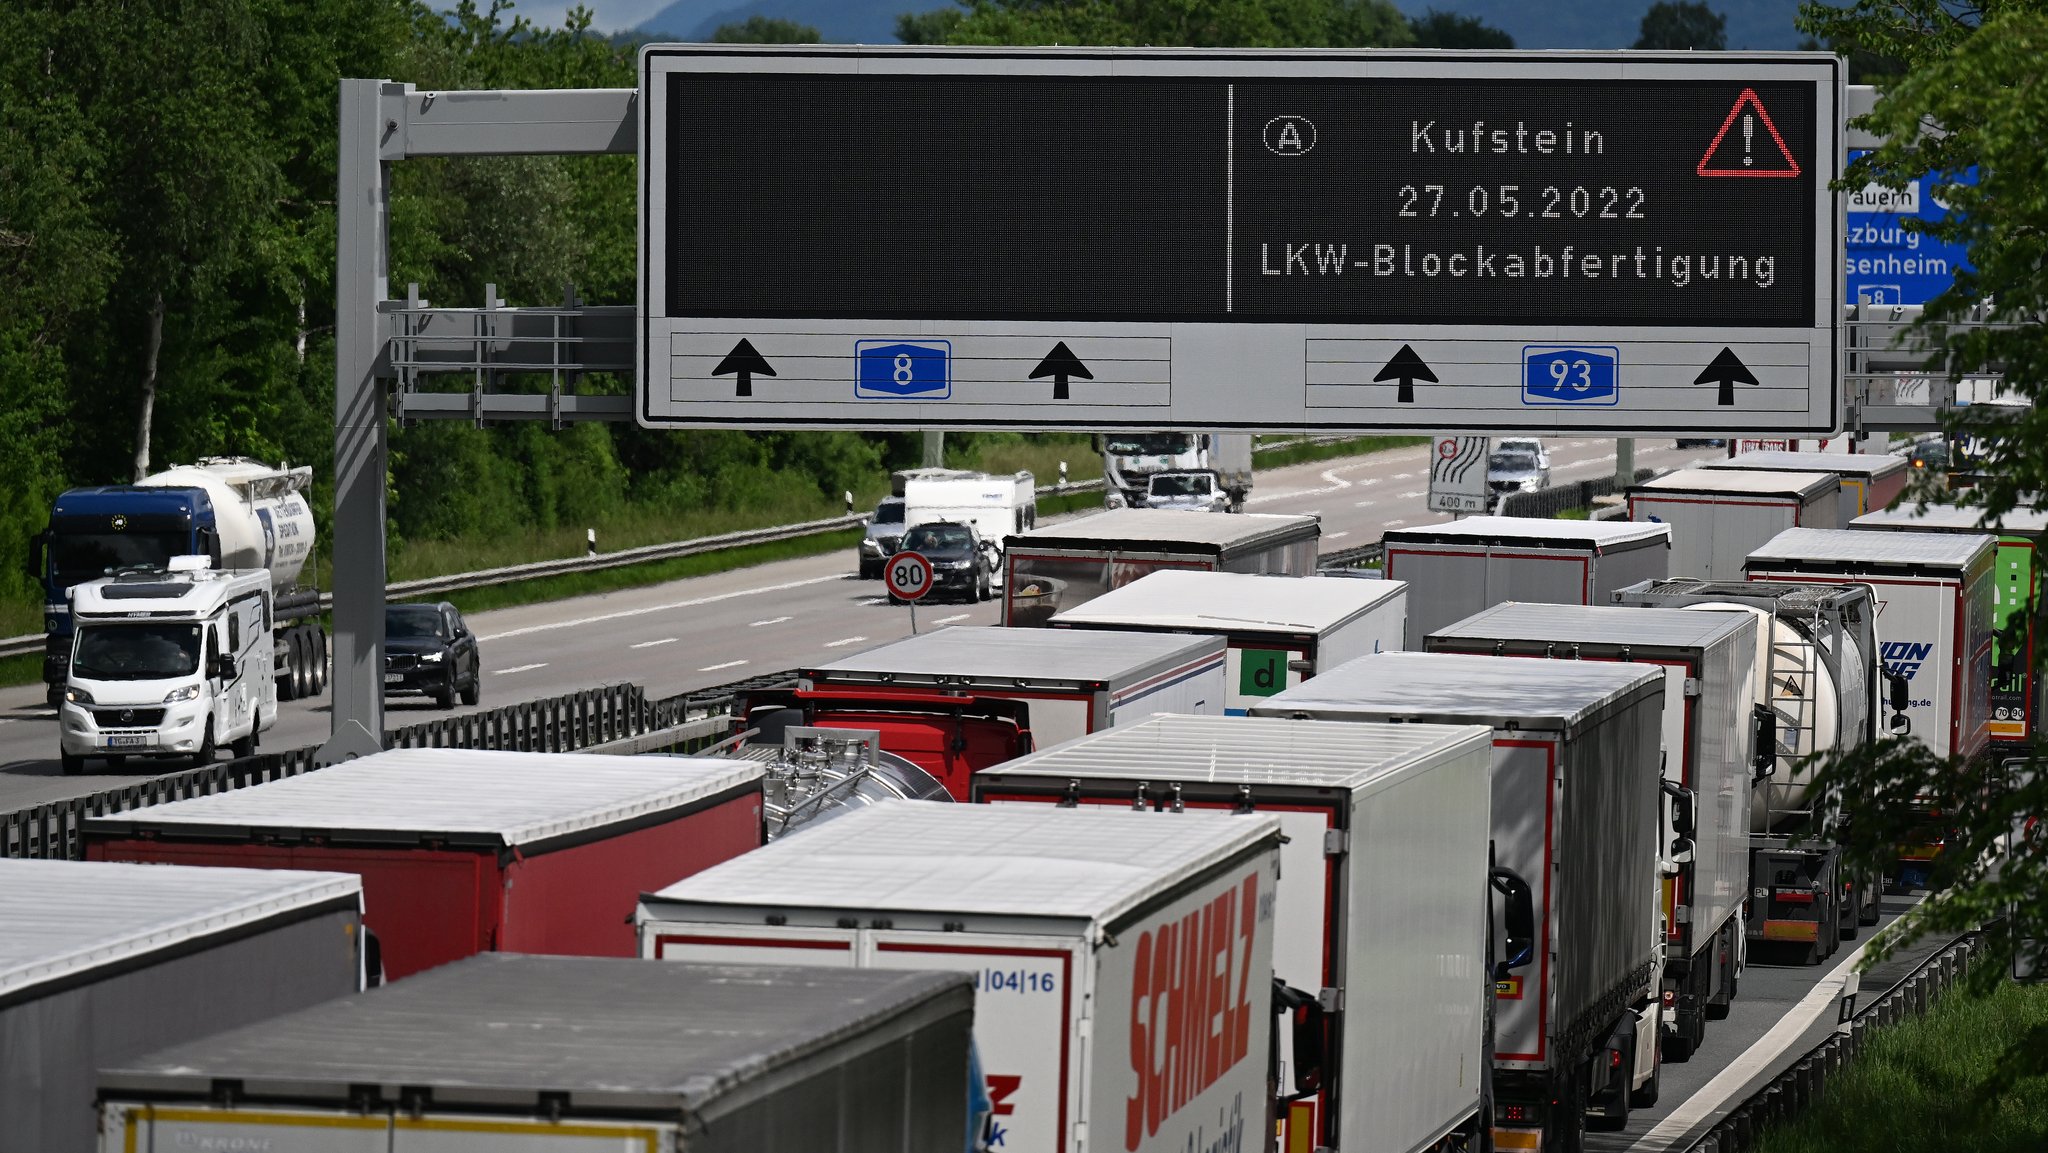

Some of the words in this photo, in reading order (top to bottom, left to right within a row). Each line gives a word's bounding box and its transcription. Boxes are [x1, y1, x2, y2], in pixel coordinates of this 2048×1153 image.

[1278, 122, 1302, 149] A
[1412, 120, 1603, 153] Kufstein
[1398, 184, 1645, 219] 27.05.2022
[1846, 191, 1912, 206] auern
[1262, 243, 1775, 288] LKW-Blockabfertigung
[893, 353, 913, 386] 8
[1549, 359, 1591, 392] 93
[1440, 496, 1460, 508] 400
[1465, 500, 1476, 508] m
[895, 564, 922, 586] 80
[1880, 642, 1933, 661] ION
[1254, 658, 1275, 688] d
[1755, 888, 1766, 896] PL
[1125, 871, 1258, 1152] SCHMELZ
